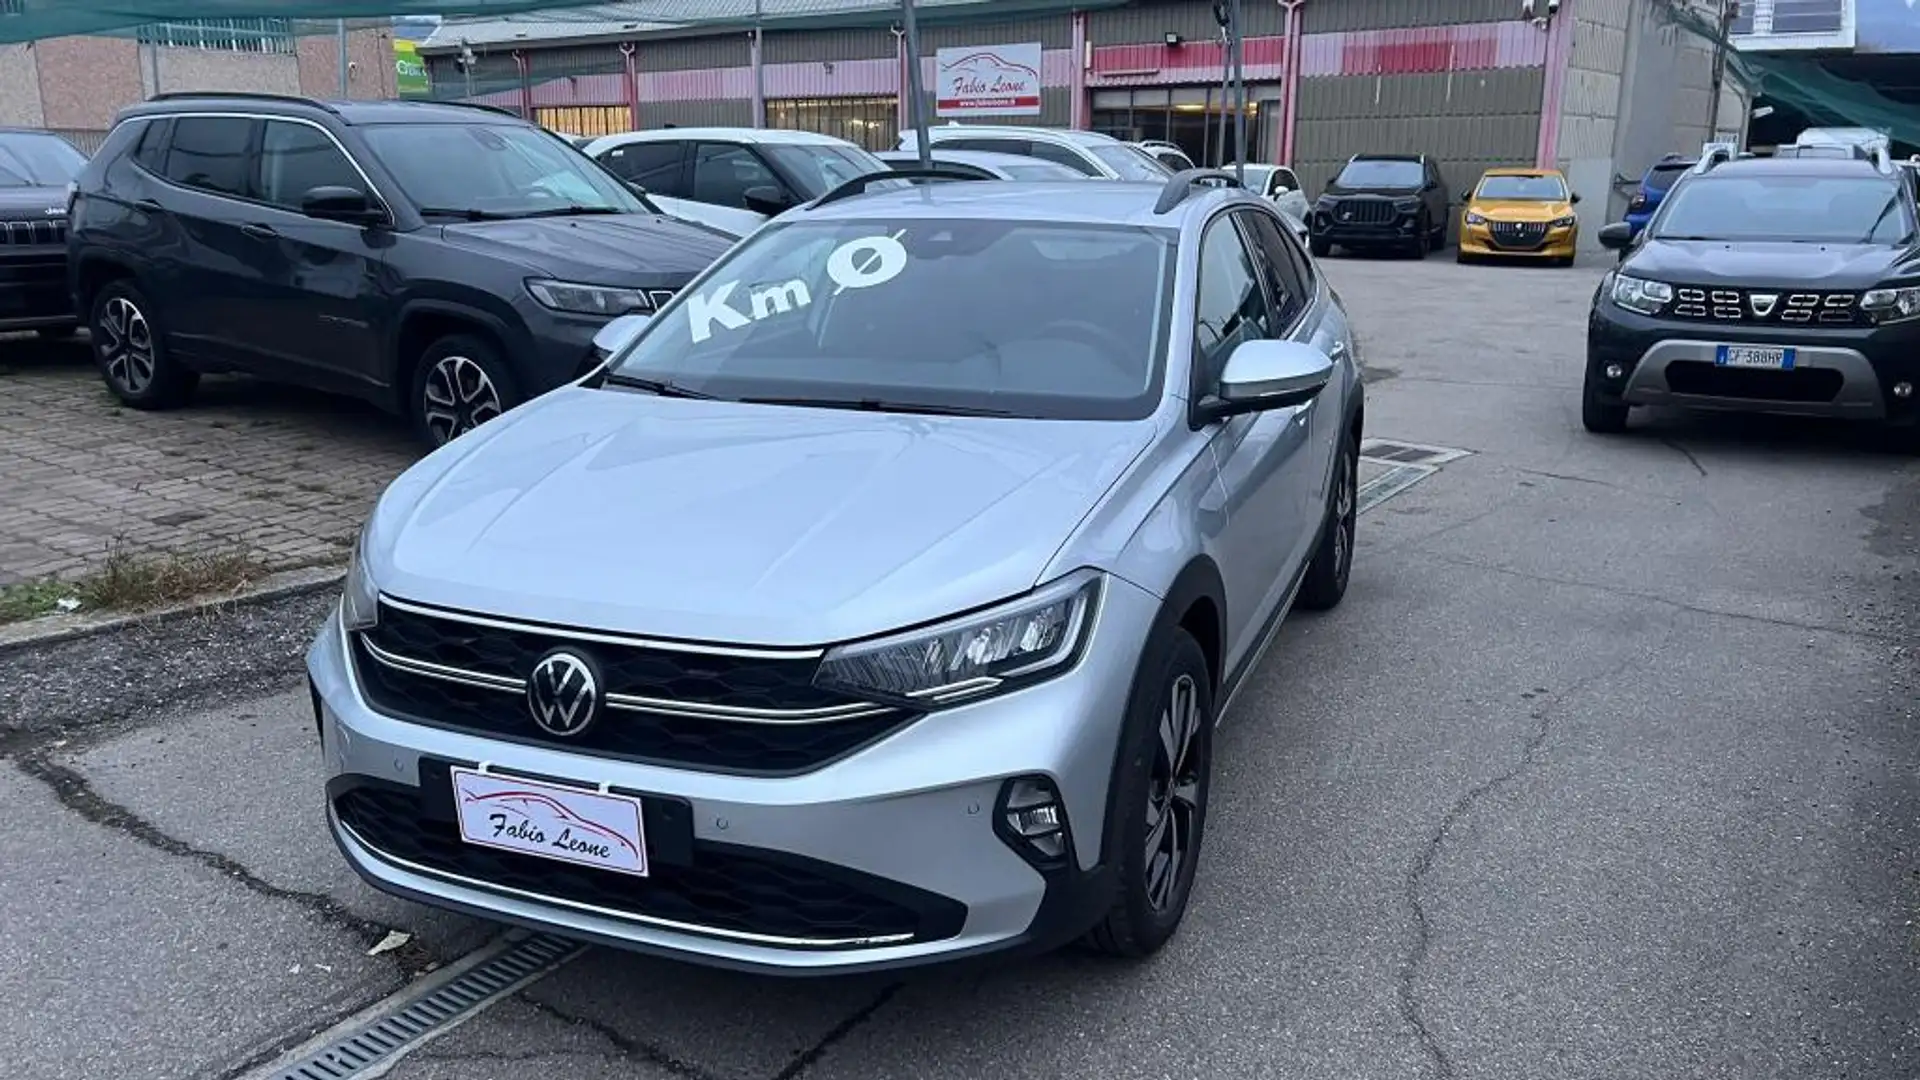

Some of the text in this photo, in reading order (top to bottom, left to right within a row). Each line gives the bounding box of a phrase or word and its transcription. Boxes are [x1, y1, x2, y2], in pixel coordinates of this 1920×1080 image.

[953, 75, 1025, 96] Fabio Leone
[688, 279, 812, 344] Km
[489, 813, 611, 859] Fabio Leone
